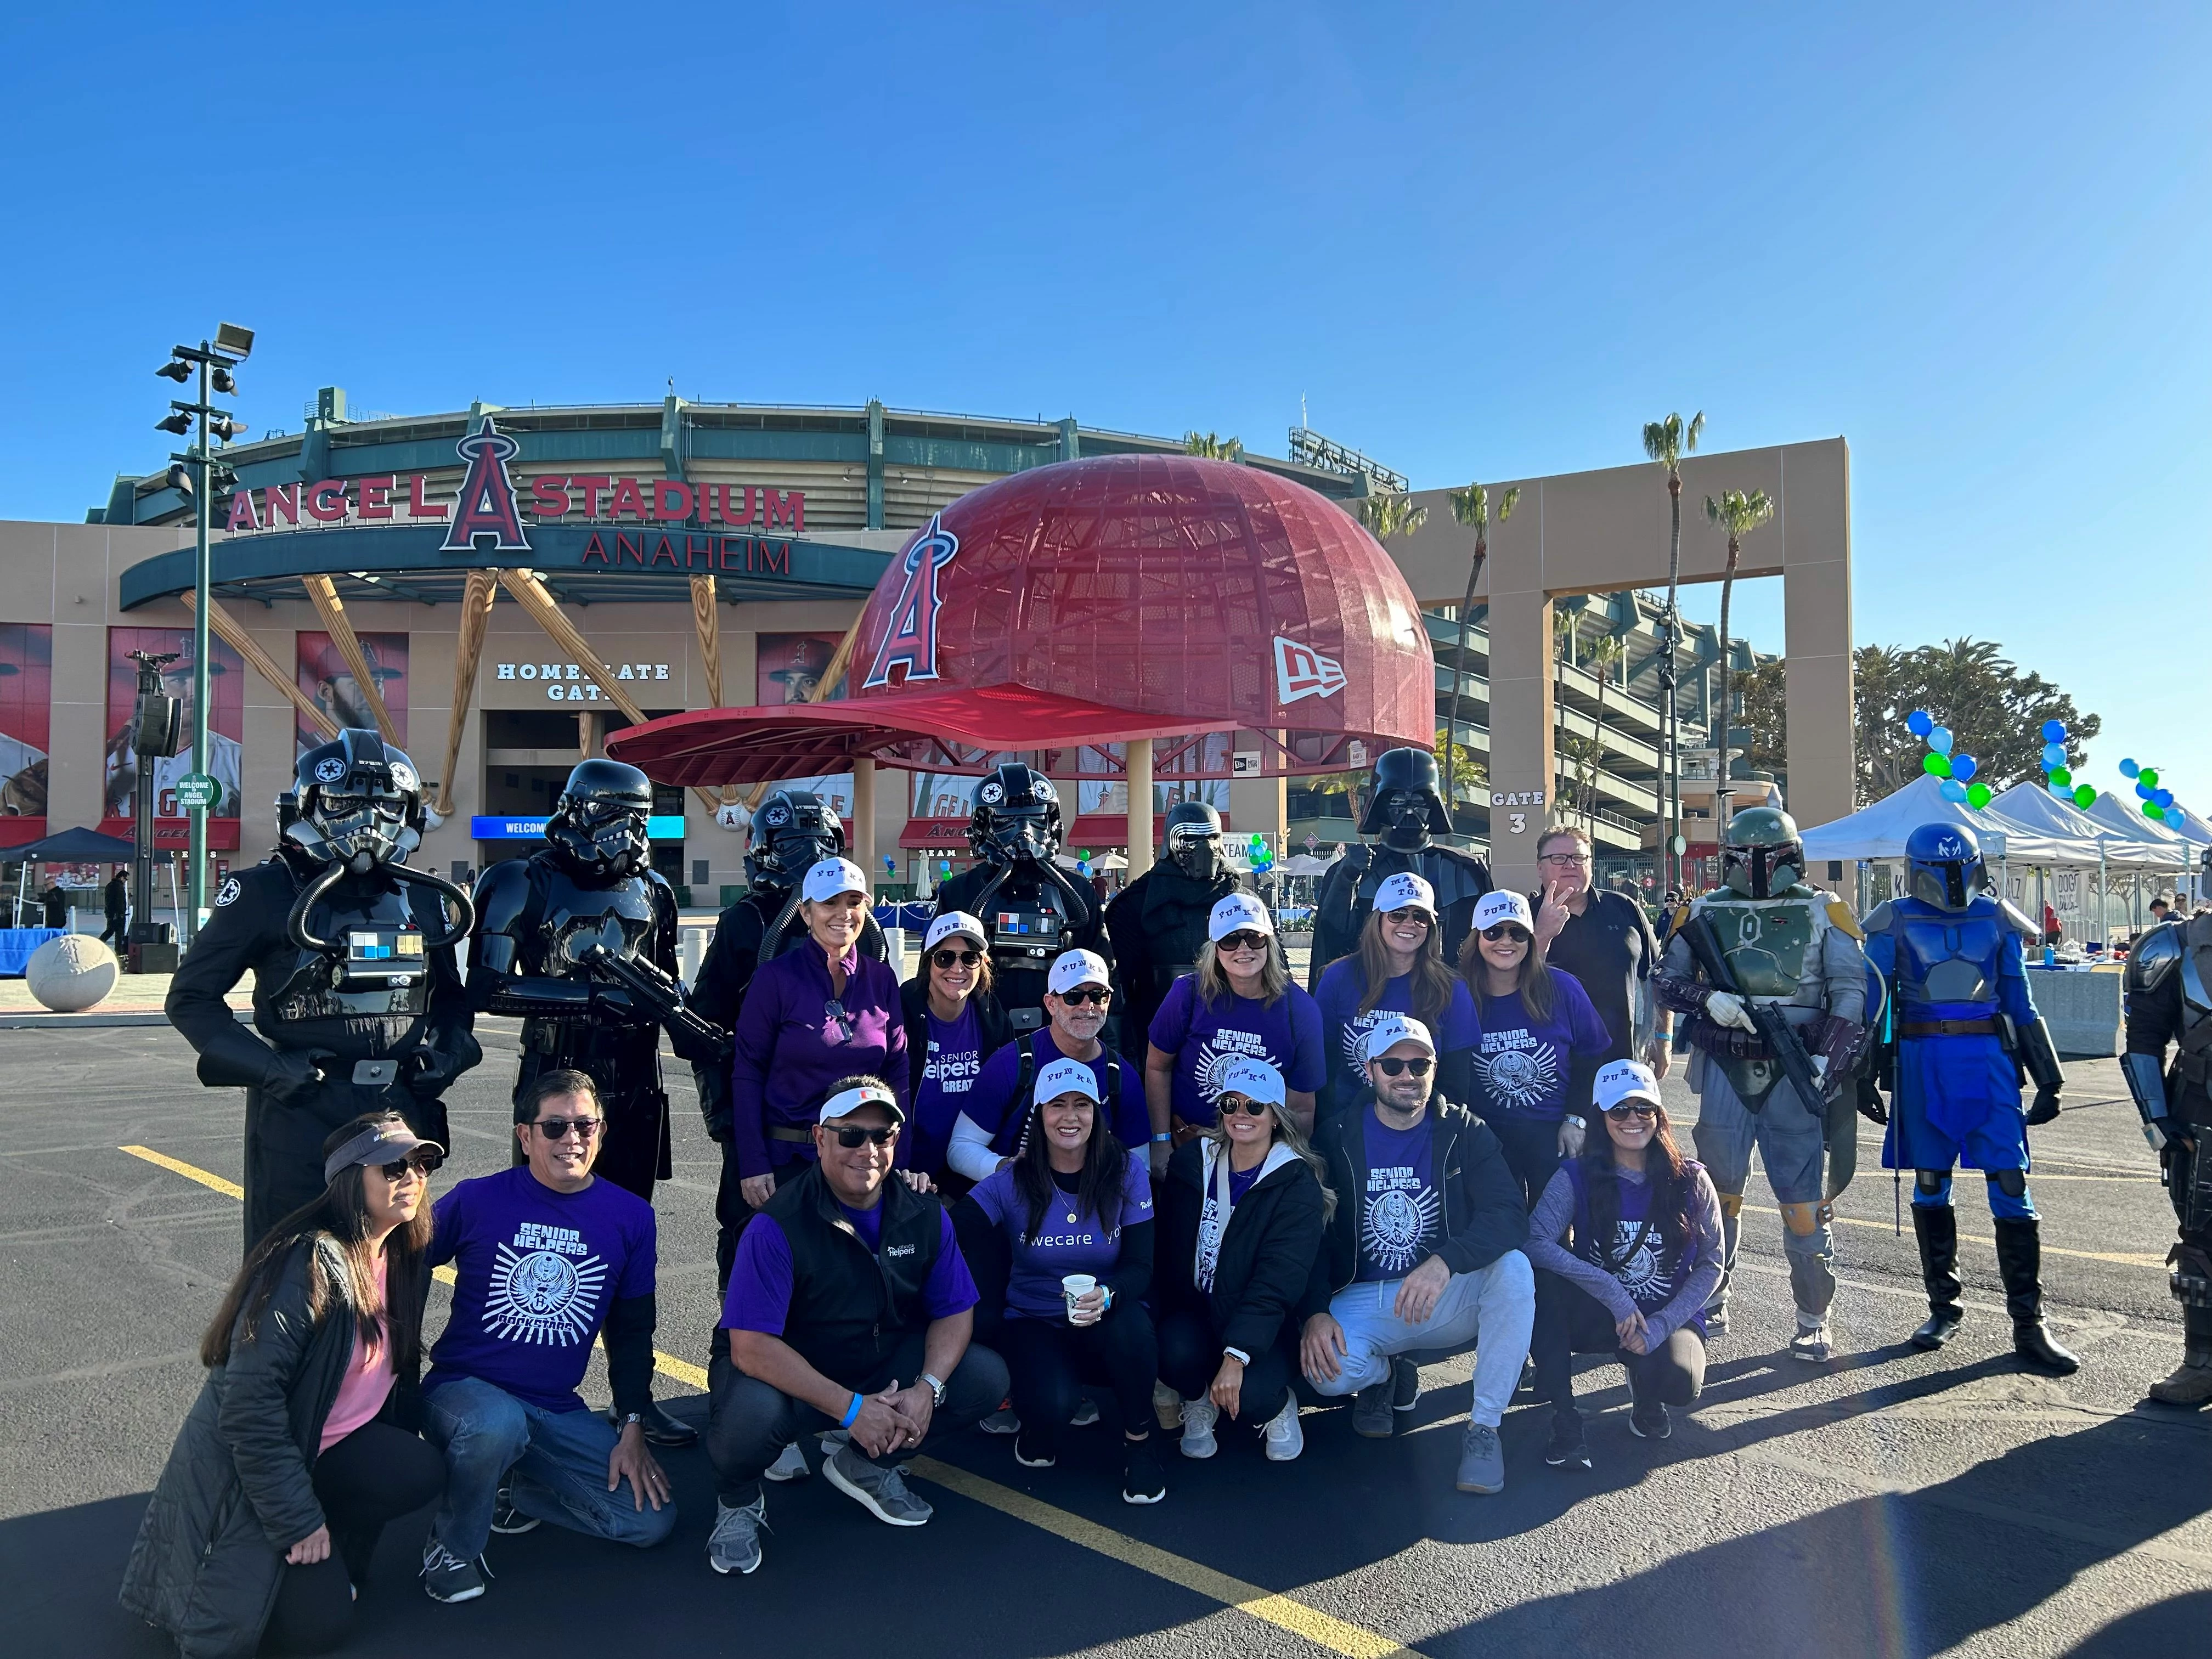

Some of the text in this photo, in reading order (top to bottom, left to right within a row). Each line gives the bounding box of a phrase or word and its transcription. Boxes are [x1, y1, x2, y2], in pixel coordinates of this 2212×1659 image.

[225, 475, 806, 532] ANGEL STADIUM
[582, 531, 789, 574] ANAHEIM
[548, 685, 611, 701] GAT
[1491, 792, 1544, 806] GATE
[506, 823, 547, 833] WELCOM
[1509, 814, 1526, 833] 3
[1646, 878, 1652, 887] 3
[1397, 888, 1423, 898] TOM
[1218, 905, 1260, 919] PUNKA
[1062, 960, 1103, 973] PUNKA
[1216, 1029, 1262, 1046] SENIOR
[1386, 1026, 1420, 1036] PAPA
[1482, 1028, 1529, 1043] SENIOR
[1212, 1038, 1267, 1057] HELPERS
[1481, 1036, 1538, 1053] HELPERS
[940, 1050, 979, 1063] SENIOR
[923, 1060, 980, 1082] elpers
[1047, 1068, 1092, 1085] PUNKA
[1228, 1068, 1267, 1082] PUNKA
[1602, 1068, 1650, 1083] PUNKA
[1370, 1166, 1414, 1180] SENIOR
[1367, 1178, 1421, 1192] HELPERS
[520, 1222, 580, 1243] SENIOR
[513, 1234, 588, 1256] HELPERS
[888, 1246, 915, 1257] Helpers
[498, 1313, 573, 1331] ROCKSTARS
